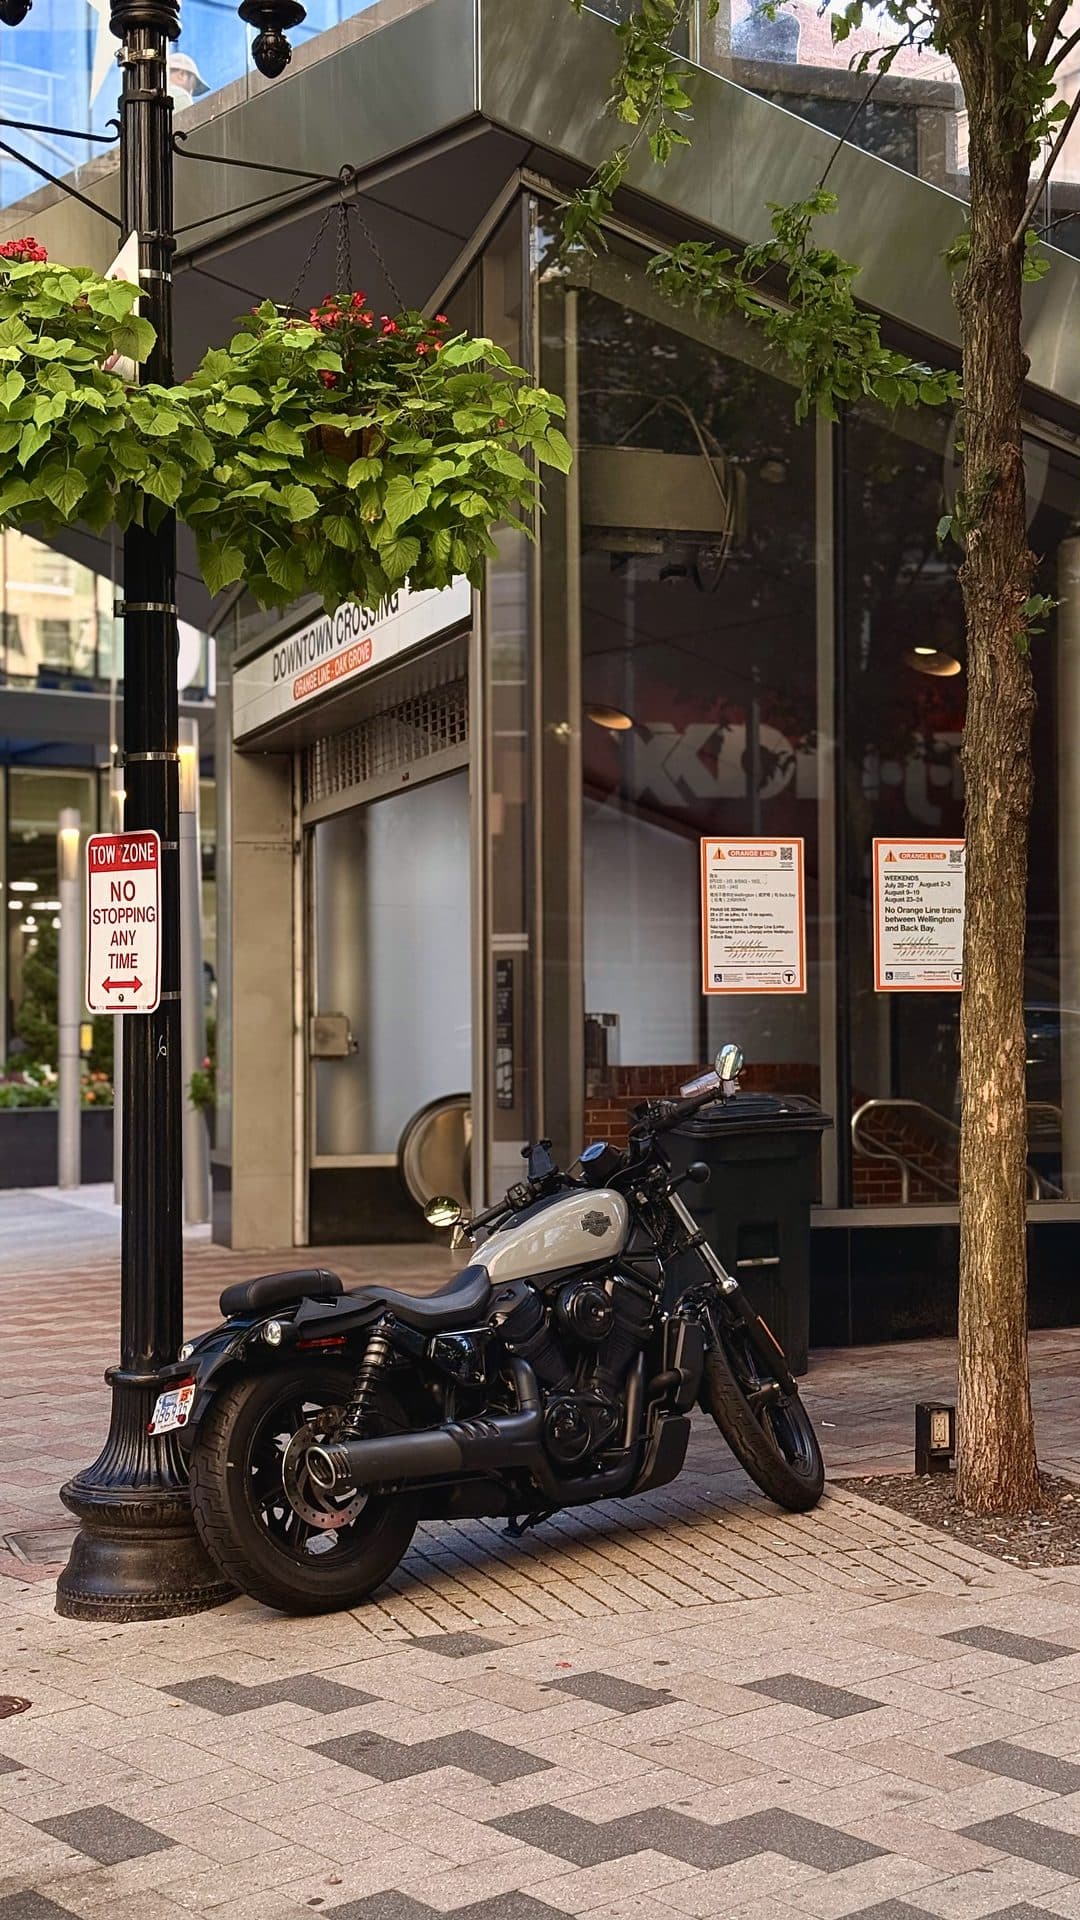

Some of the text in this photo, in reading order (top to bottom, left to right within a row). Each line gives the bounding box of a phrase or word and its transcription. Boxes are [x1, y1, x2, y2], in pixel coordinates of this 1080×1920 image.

[273, 620, 333, 681] DOWNTOWN
[295, 671, 318, 698] ORANGE
[318, 663, 331, 686] LINE
[335, 653, 348, 677] OAK
[349, 641, 370, 669] GROVE
[91, 842, 156, 865] TOW ZONE
[111, 880, 135, 902] NO
[884, 889, 905, 897] August
[93, 906, 155, 924] STOPPING
[897, 906, 923, 915] Orange
[918, 916, 954, 924] Wellington
[920, 925, 935, 933] Bay.
[110, 930, 136, 946] ANY
[108, 953, 138, 969] TIME
